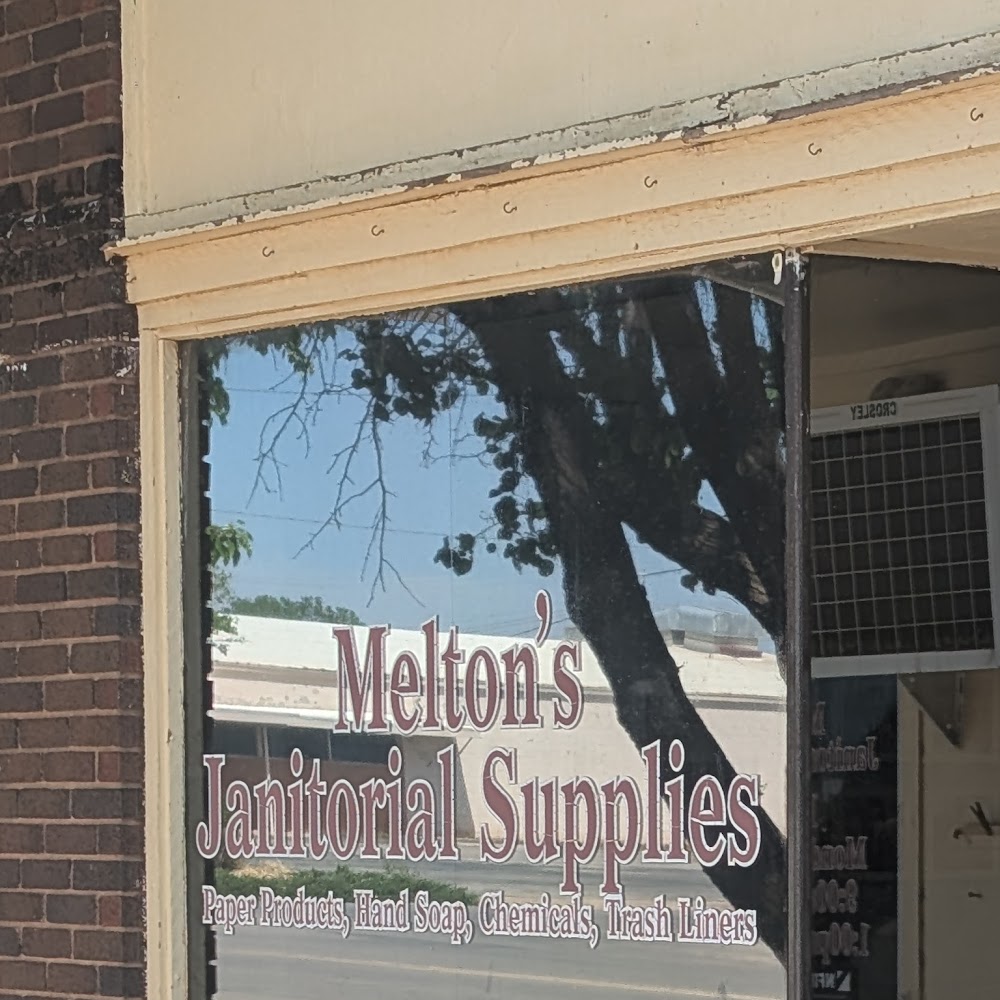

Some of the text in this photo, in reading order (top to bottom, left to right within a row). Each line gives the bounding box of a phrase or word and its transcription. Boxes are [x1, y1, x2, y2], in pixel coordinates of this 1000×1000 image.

[332, 589, 583, 734] Melton's
[196, 738, 762, 897] Janitorial Supplies
[202, 885, 758, 949] Paper Products, Hand Soap, Chemicals, Trash Liners
